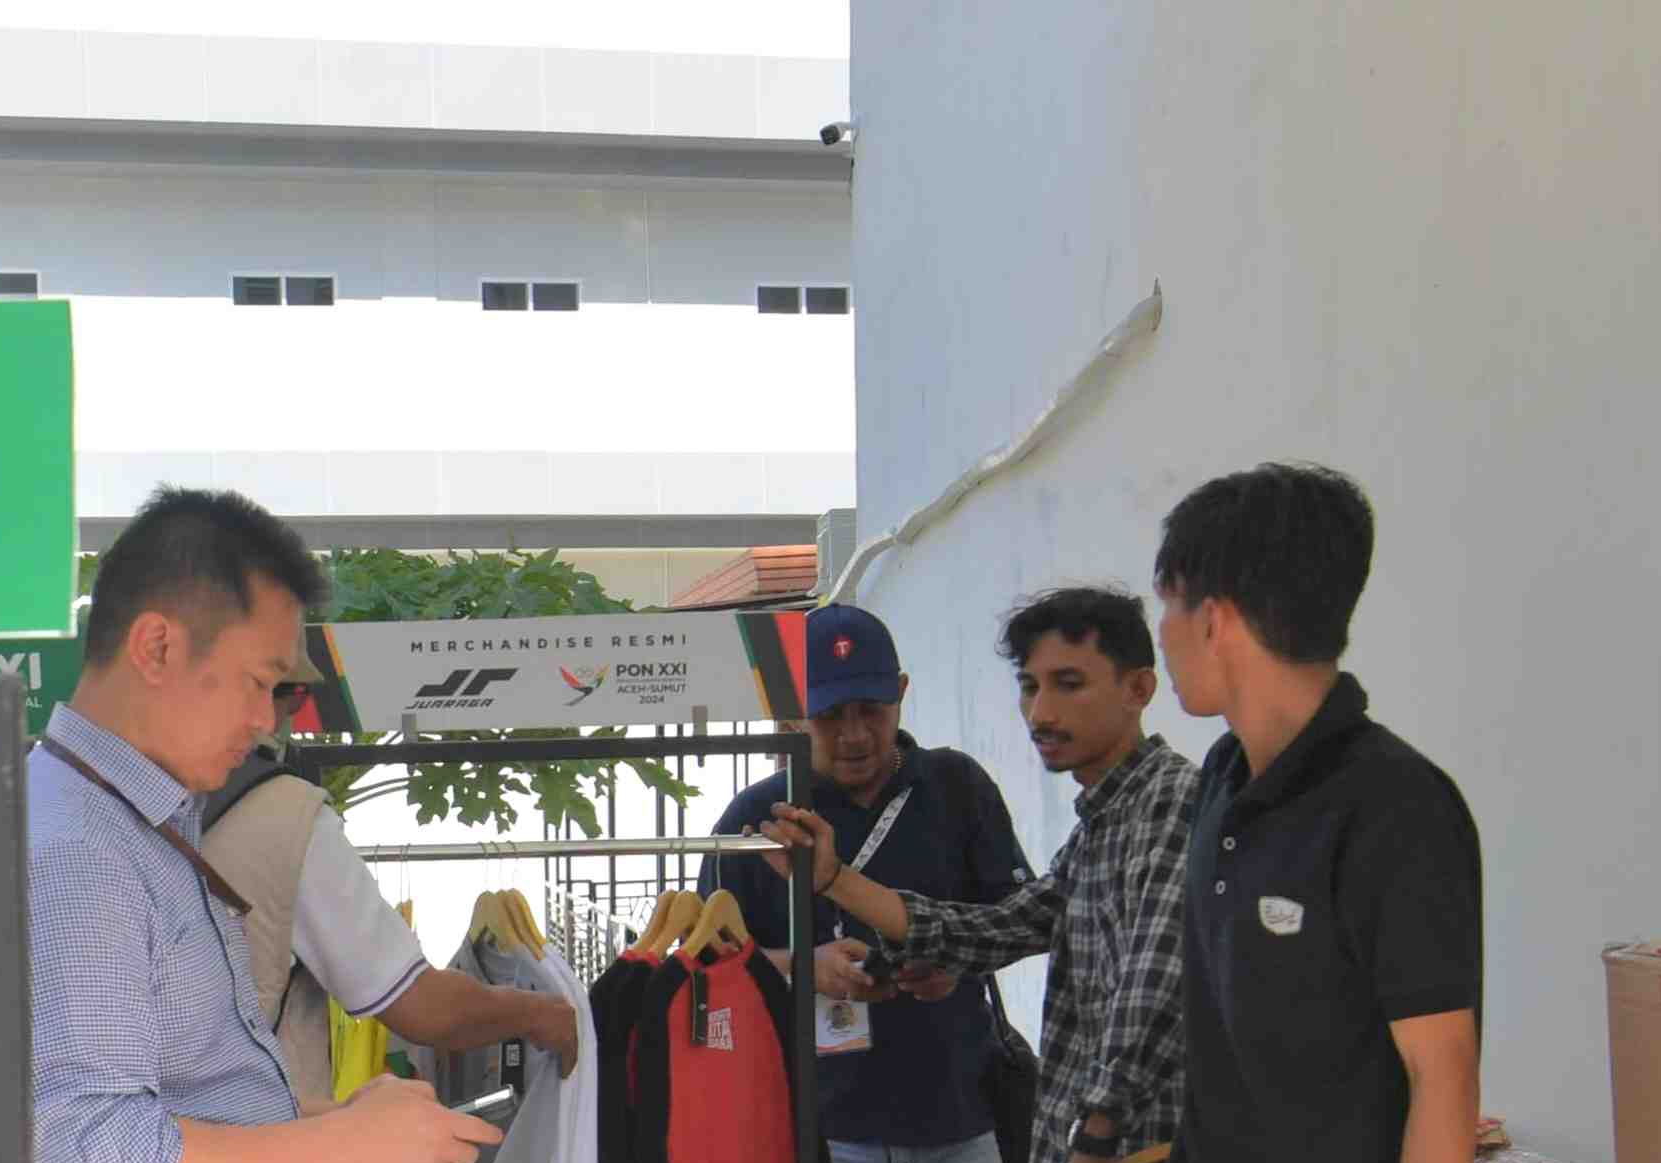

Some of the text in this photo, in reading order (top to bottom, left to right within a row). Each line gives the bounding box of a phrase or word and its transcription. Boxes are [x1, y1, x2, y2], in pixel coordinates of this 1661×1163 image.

[410, 633, 687, 653] MERCHANDISE RESMI
[615, 662, 687, 678] PON XXI
